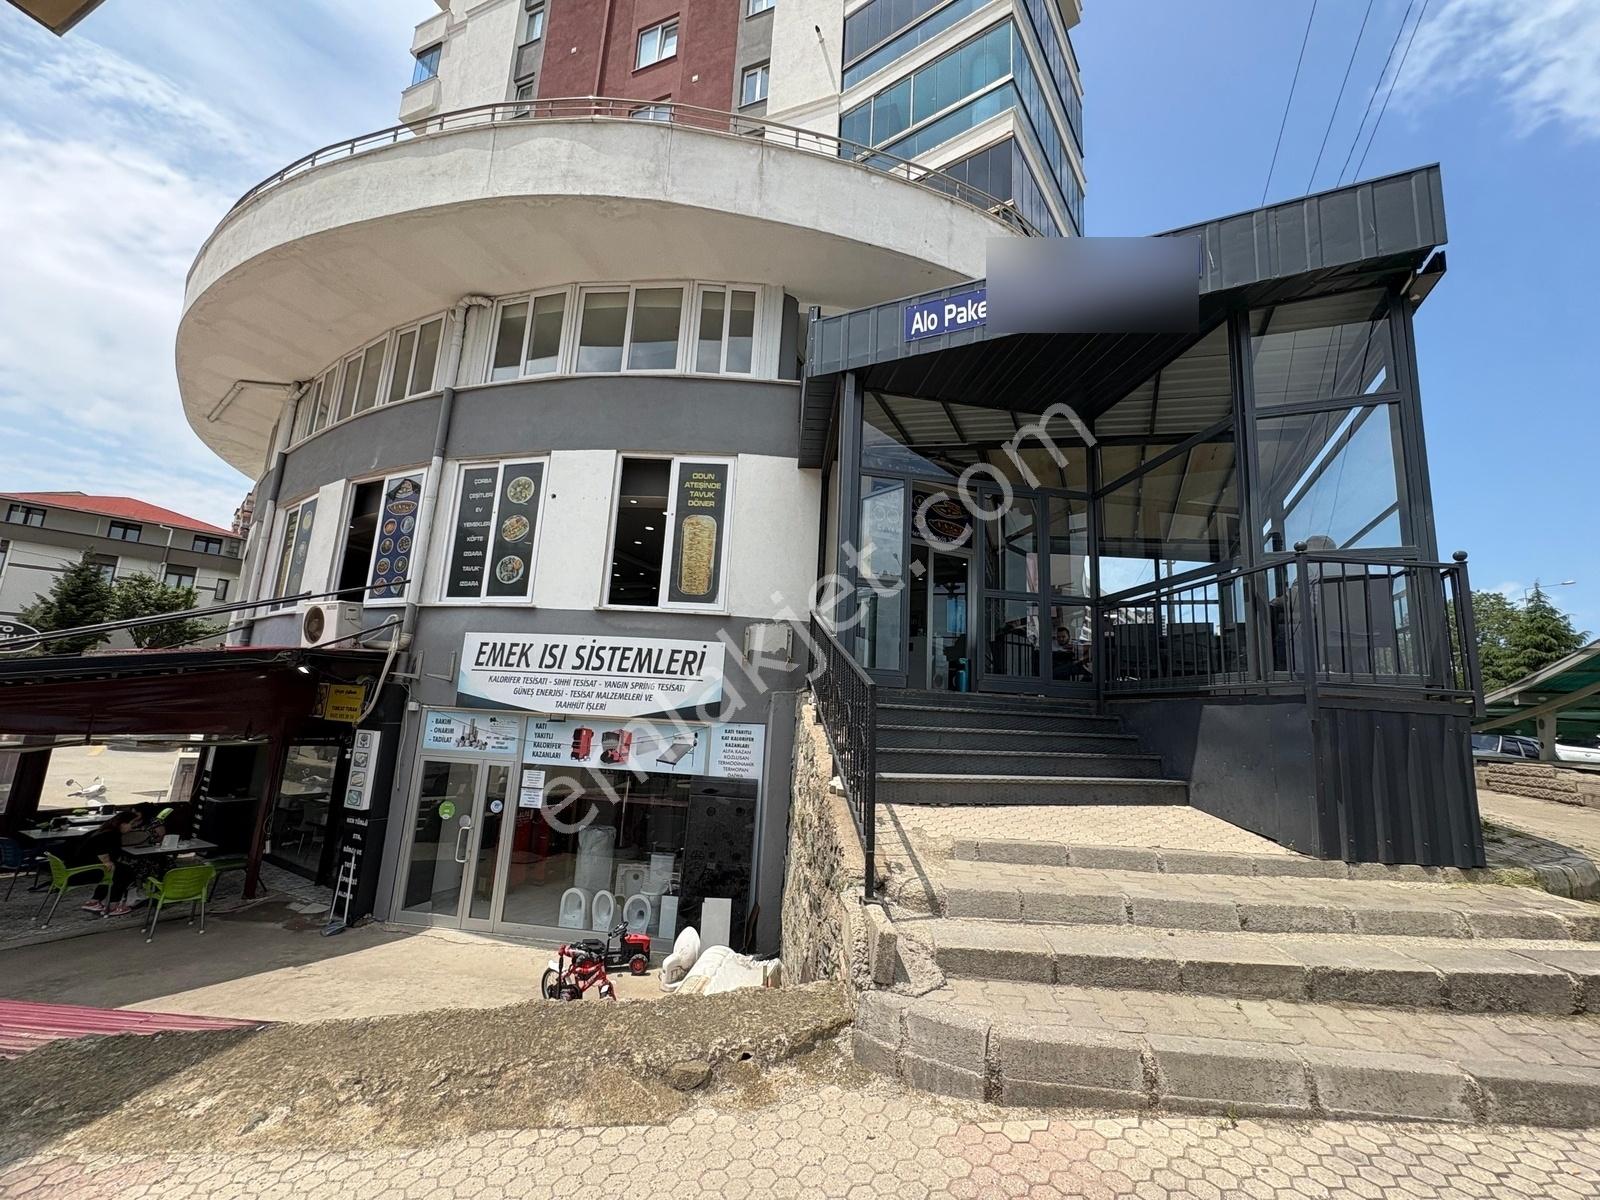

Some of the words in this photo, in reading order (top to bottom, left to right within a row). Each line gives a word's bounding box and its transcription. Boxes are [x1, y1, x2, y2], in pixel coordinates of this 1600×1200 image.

[911, 310, 938, 335] Alo
[692, 472, 715, 480] ODUN
[684, 481, 721, 490] ATEŞİNDE
[689, 490, 715, 498] TAVUK
[687, 498, 715, 508] DÖNER
[474, 642, 534, 668] EMEK
[538, 643, 568, 669] ISI
[571, 639, 707, 677] SİSTEMLERİ
[488, 675, 521, 684] KALORİFER
[522, 676, 548, 685] TESİSATI
[572, 679, 598, 688] TESİSAT
[604, 681, 630, 690] YANGIN
[513, 686, 535, 697] GÜNEŞ
[570, 690, 595, 699] TESİSAT
[596, 691, 643, 701] MALZEMELERİ
[644, 694, 654, 702] VE
[555, 700, 585, 709] TAAHHÜT
[535, 722, 548, 730] KATI
[534, 732, 554, 740] YAKITLI
[532, 741, 562, 750] KALORİFER
[531, 750, 561, 759] KAZANLARI
